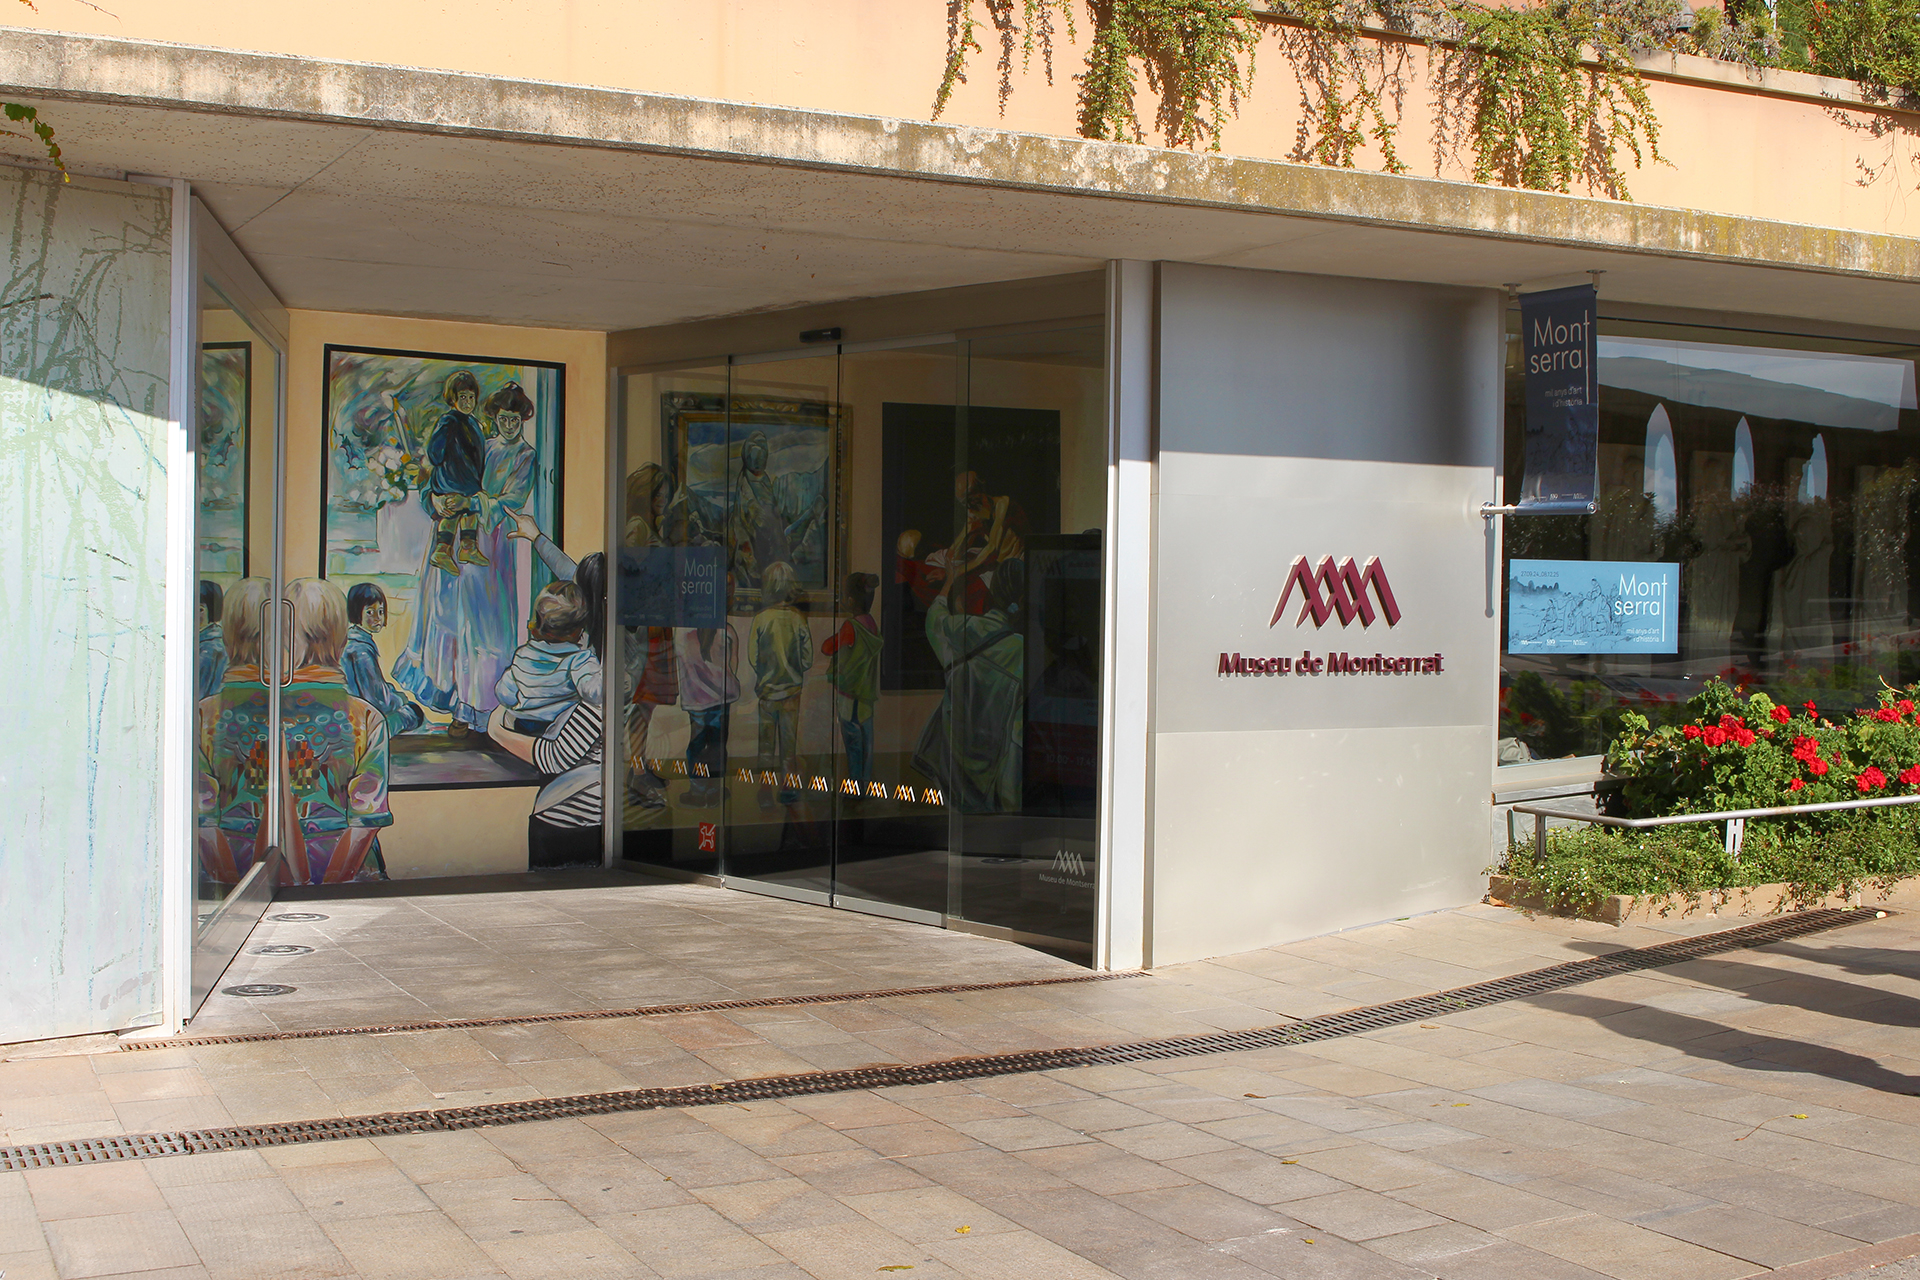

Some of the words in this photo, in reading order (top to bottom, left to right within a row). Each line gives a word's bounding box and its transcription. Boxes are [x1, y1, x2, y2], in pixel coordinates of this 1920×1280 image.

[1218, 652, 1292, 675] Museu
[1296, 650, 1324, 674] de
[1327, 652, 1445, 675] Montserrat
[1039, 873, 1057, 884] Museu
[1058, 876, 1066, 885] de
